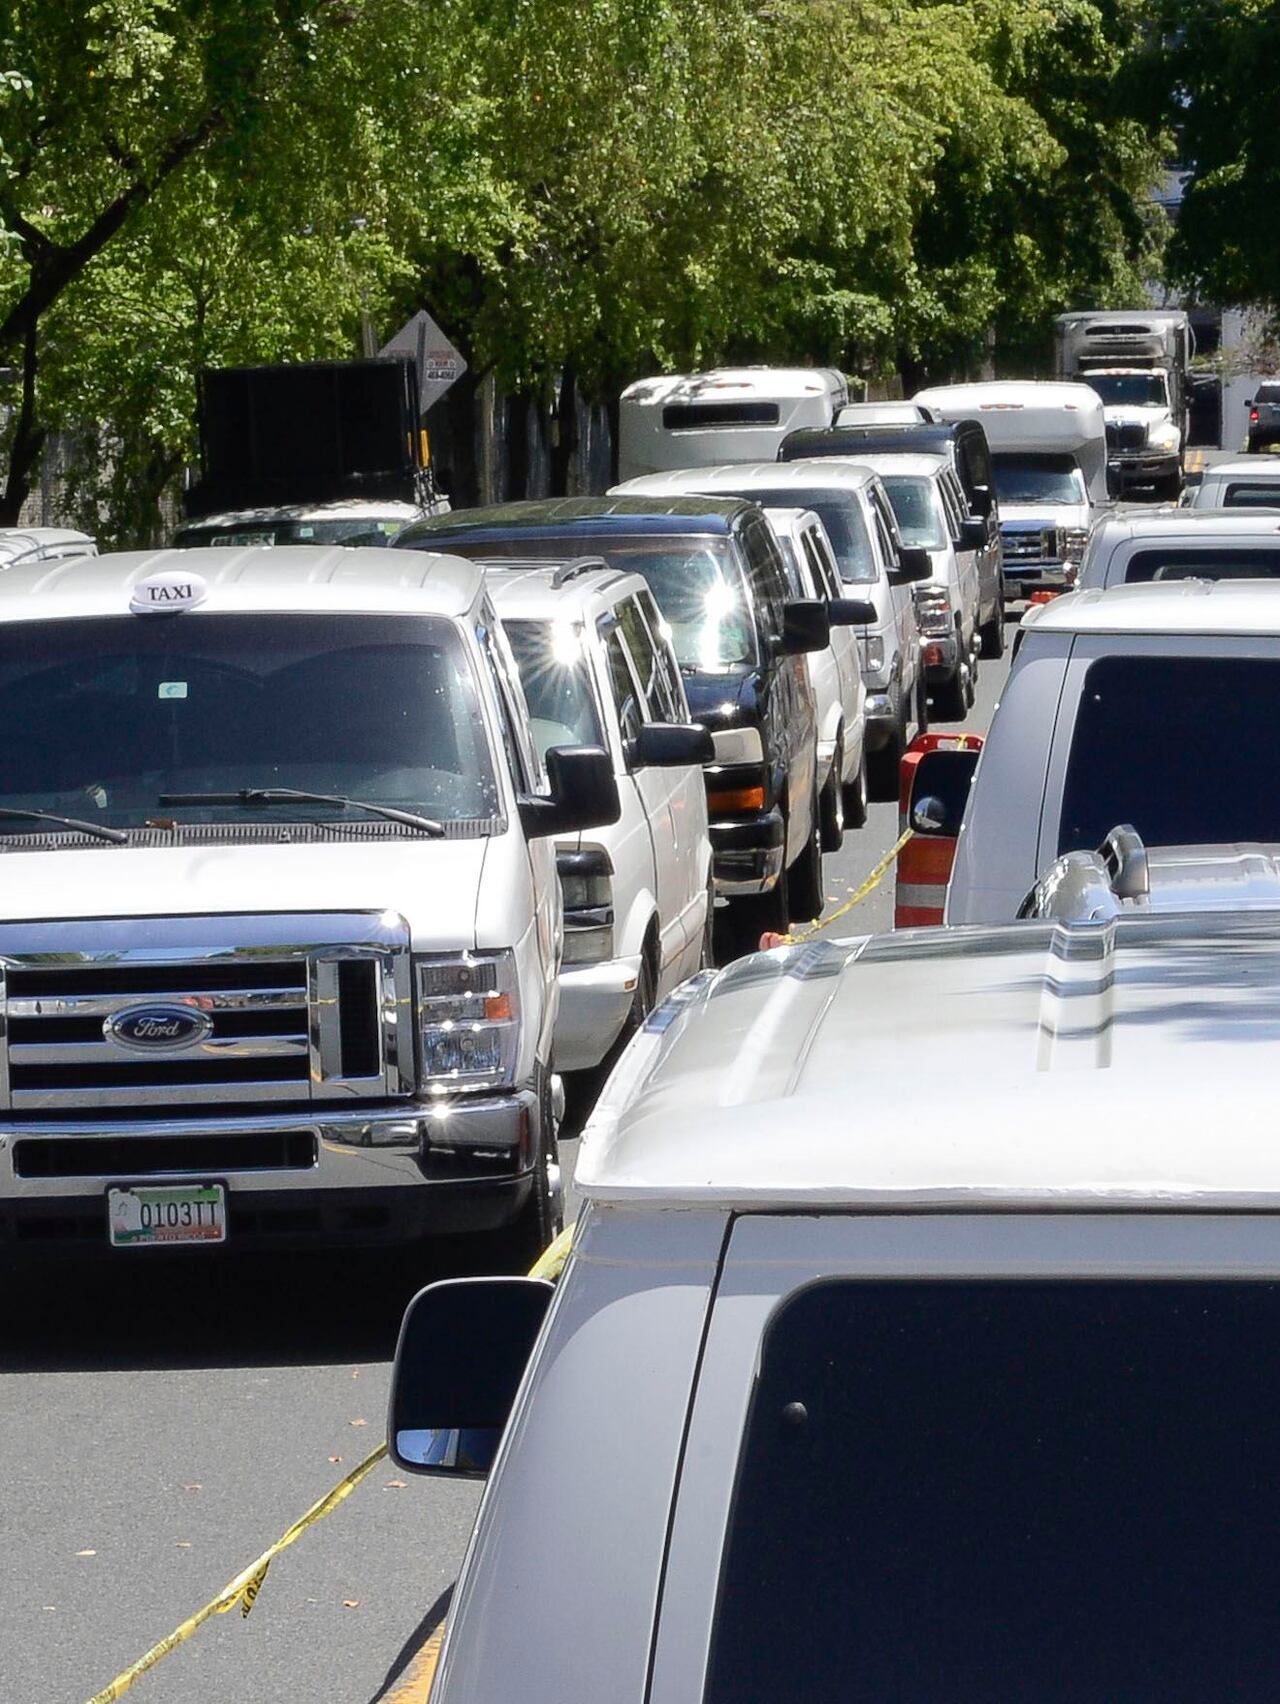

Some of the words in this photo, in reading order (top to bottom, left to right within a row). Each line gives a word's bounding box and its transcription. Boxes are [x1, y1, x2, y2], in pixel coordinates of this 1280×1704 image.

[147, 583, 192, 601] TAXI
[133, 1016, 180, 1037] Ford
[141, 1200, 218, 1229] 0103TT
